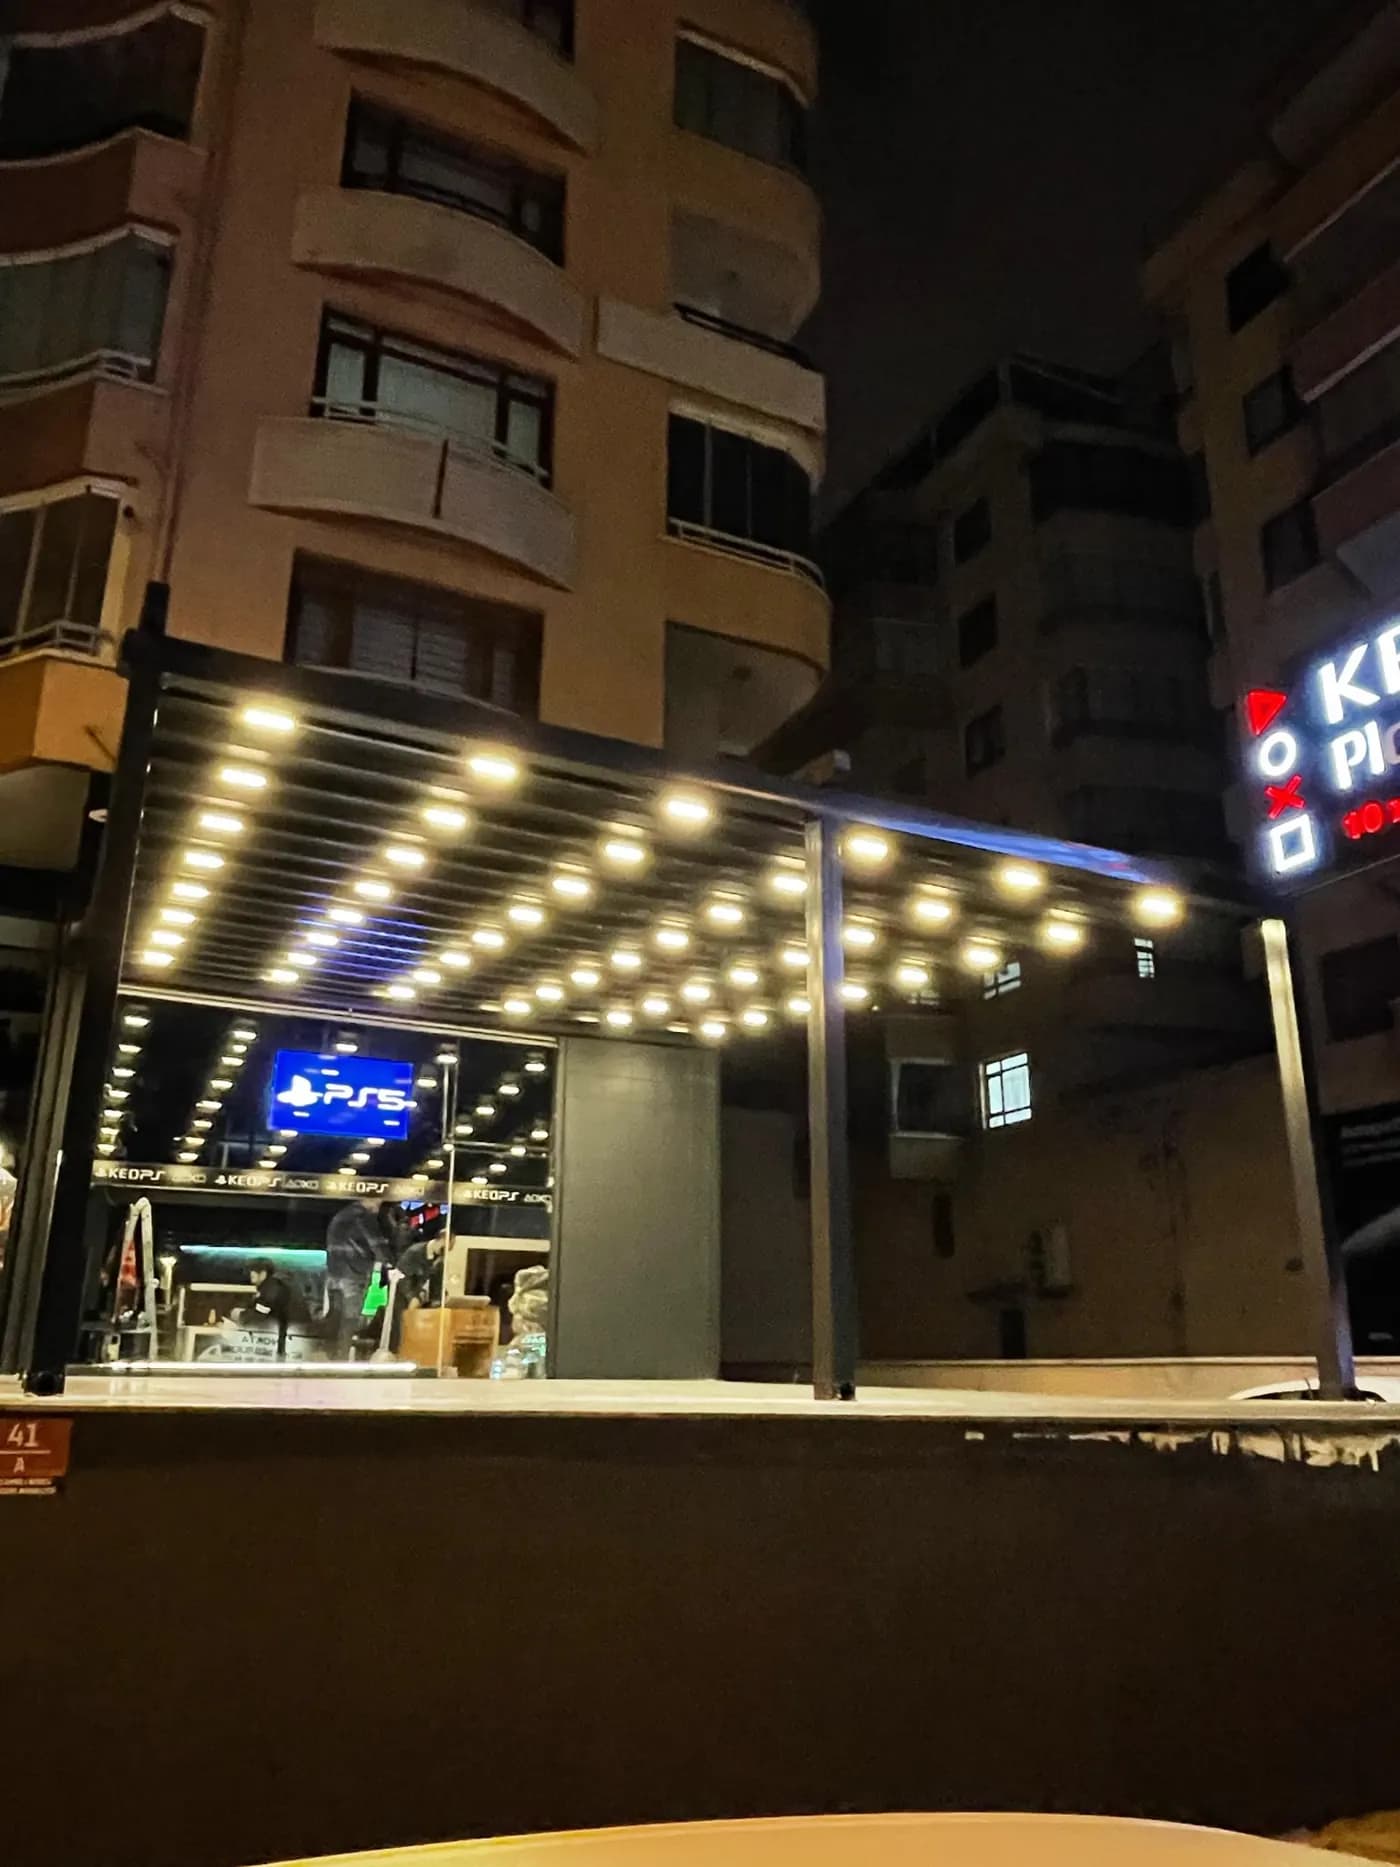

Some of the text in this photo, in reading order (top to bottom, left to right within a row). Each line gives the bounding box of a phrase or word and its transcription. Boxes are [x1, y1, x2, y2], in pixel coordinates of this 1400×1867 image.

[323, 1083, 407, 1111] PS5
[108, 1167, 166, 1181] KEOPS
[473, 1190, 520, 1202] KEOPS
[7, 1423, 39, 1447] 41
